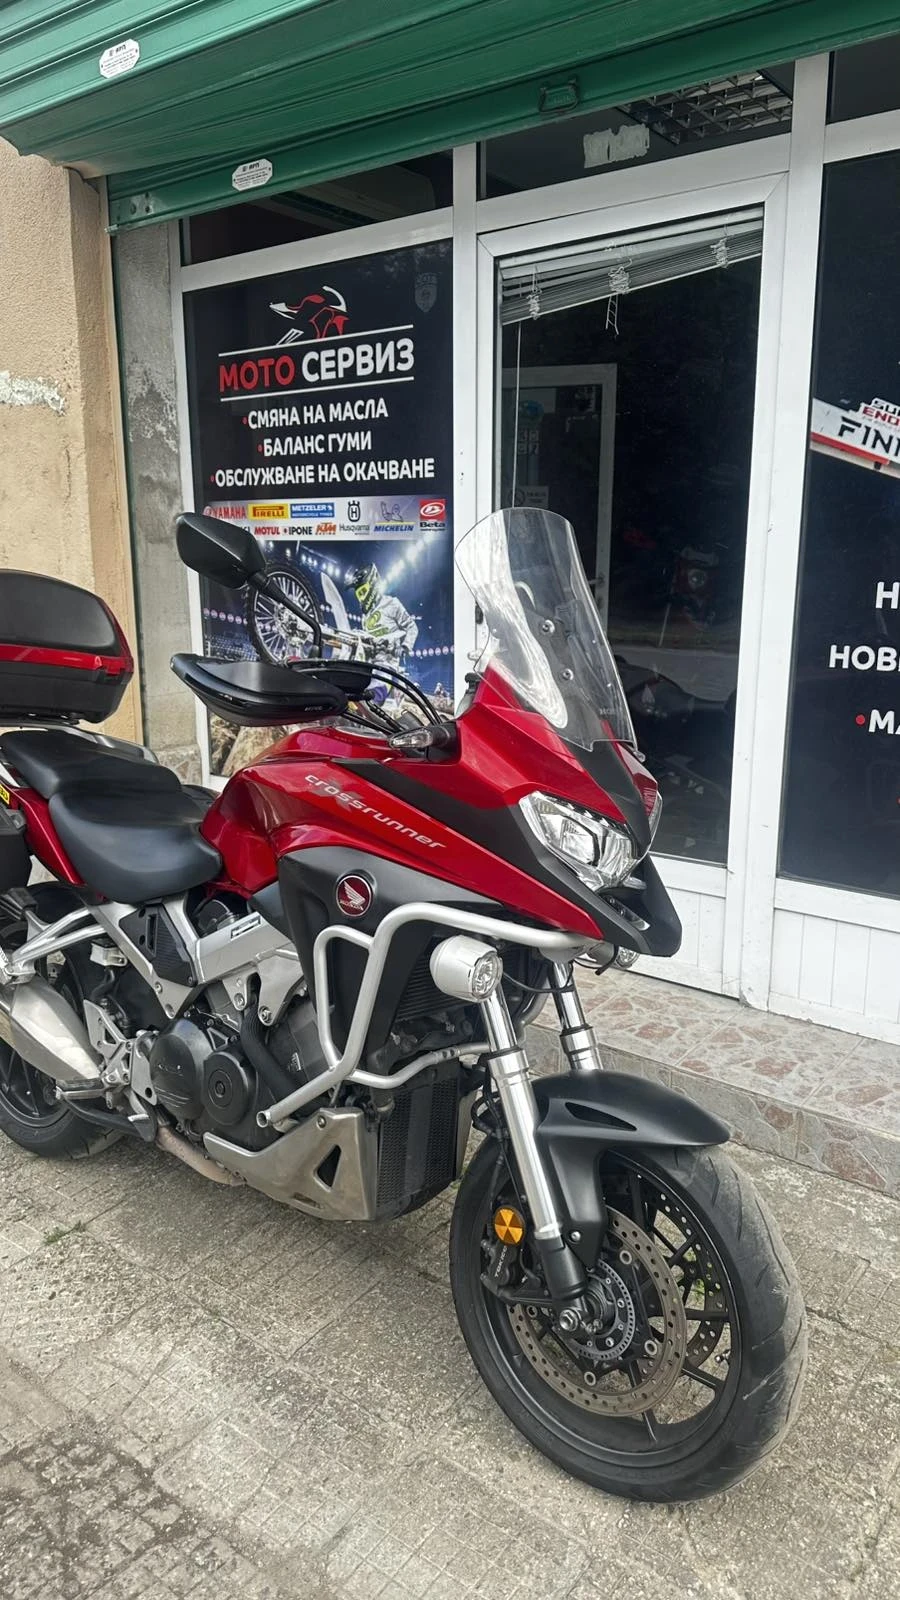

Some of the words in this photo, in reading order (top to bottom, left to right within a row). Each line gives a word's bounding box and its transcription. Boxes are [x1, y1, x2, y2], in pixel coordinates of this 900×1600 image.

[218, 355, 296, 392] МОТО
[302, 338, 415, 382] СЕРВИЗ
[248, 406, 301, 429] СМЯНА
[303, 404, 326, 425] НА
[329, 398, 389, 421] МАСЛА
[873, 400, 900, 417] SU
[263, 434, 325, 456] БАЛАНС
[328, 431, 373, 452] ГУМИ
[215, 464, 315, 487] ОБСЛУЖВАНЕ
[318, 465, 341, 483] НА
[343, 458, 435, 481] ОКАЧВАНЕ
[215, 506, 246, 519] YAMAHA
[253, 506, 285, 517] PIRELLI
[291, 504, 327, 512] METZELER
[254, 526, 280, 535] MOTUL
[289, 526, 313, 535] IPONE
[316, 522, 337, 533] KTM
[828, 644, 900, 672] НОВ
[305, 774, 446, 849] crossrunner
